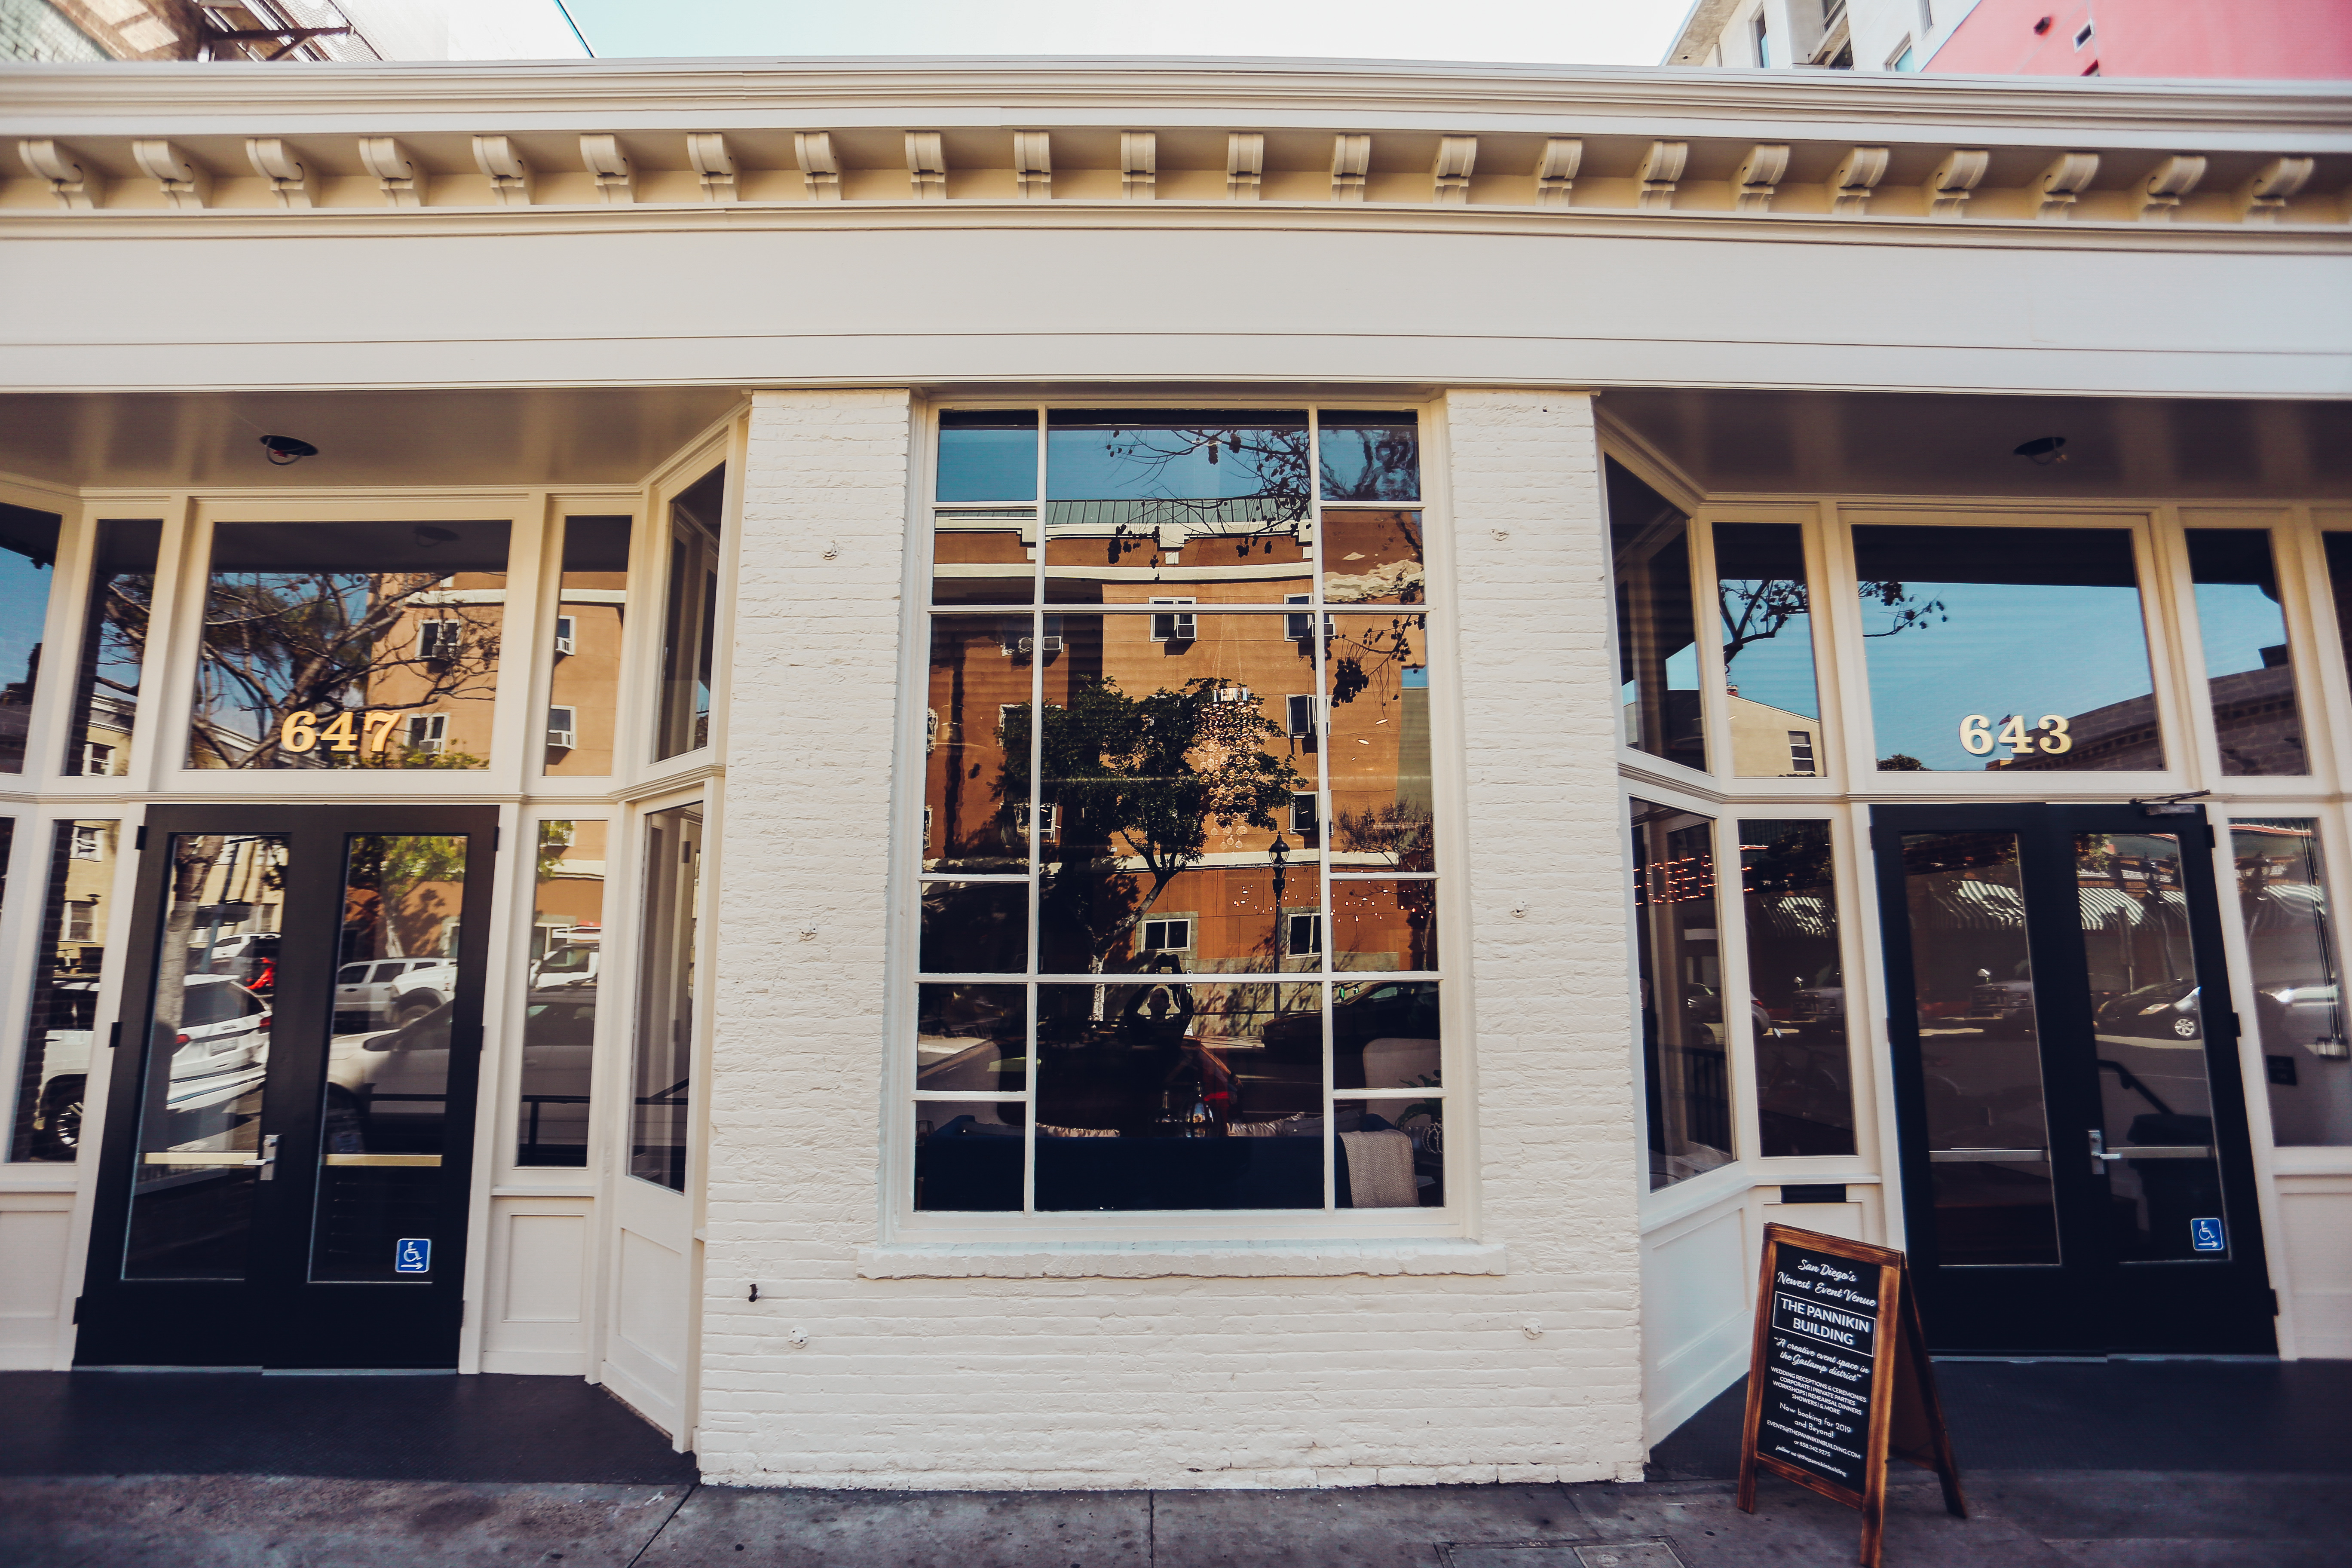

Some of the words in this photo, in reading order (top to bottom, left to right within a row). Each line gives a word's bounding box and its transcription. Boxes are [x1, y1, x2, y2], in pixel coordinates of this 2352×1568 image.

[282, 711, 401, 752] 647
[1959, 714, 2072, 754] 643
[1798, 1259, 1819, 1272] San
[1819, 1264, 1857, 1282] Diego's
[1777, 1271, 1810, 1289] Newest
[1815, 1282, 1843, 1298] Event
[1844, 1289, 1876, 1306] Venue
[1781, 1298, 1806, 1314] THE
[1807, 1305, 1869, 1332] PANNIKIN
[1793, 1317, 1853, 1345] BUILDING
[1780, 1351, 1792, 1361] the
[1792, 1354, 1828, 1373] Gaslamp
[1787, 1342, 1816, 1357] creative
[1816, 1353, 1836, 1363] event
[1836, 1359, 1859, 1370] space
[1860, 1366, 1869, 1374] in
[1771, 1366, 1796, 1379] WEDDING
[1796, 1375, 1828, 1390] RECEPTIONS
[1832, 1387, 1867, 1403] CEREMONIES
[1773, 1380, 1806, 1396] WORKSHOPS
[1808, 1392, 1838, 1407] REHEARSAL
[1838, 1403, 1862, 1415] DINNERS
[1780, 1376, 1811, 1391] CORPORATE
[1813, 1387, 1834, 1399] PRIVATE
[1834, 1394, 1856, 1406] PARTIES
[1779, 1402, 1796, 1413] Now
[1798, 1408, 1822, 1425] booking
[1824, 1418, 1834, 1427] for
[1835, 1423, 1851, 1433] 2019
[1792, 1393, 1817, 1406] SHOWERS
[1824, 1405, 1841, 1415] MORE
[1767, 1420, 1860, 1459] EVENTS@THEPANNIKINBUILDING.COM
[1794, 1420, 1807, 1428] and
[1808, 1423, 1834, 1438] Beyond!
[1776, 1445, 1790, 1454] follow
[1797, 1453, 1847, 1477] @thepannikinbuilding
[1799, 1441, 1831, 1457] 858.342.9275
